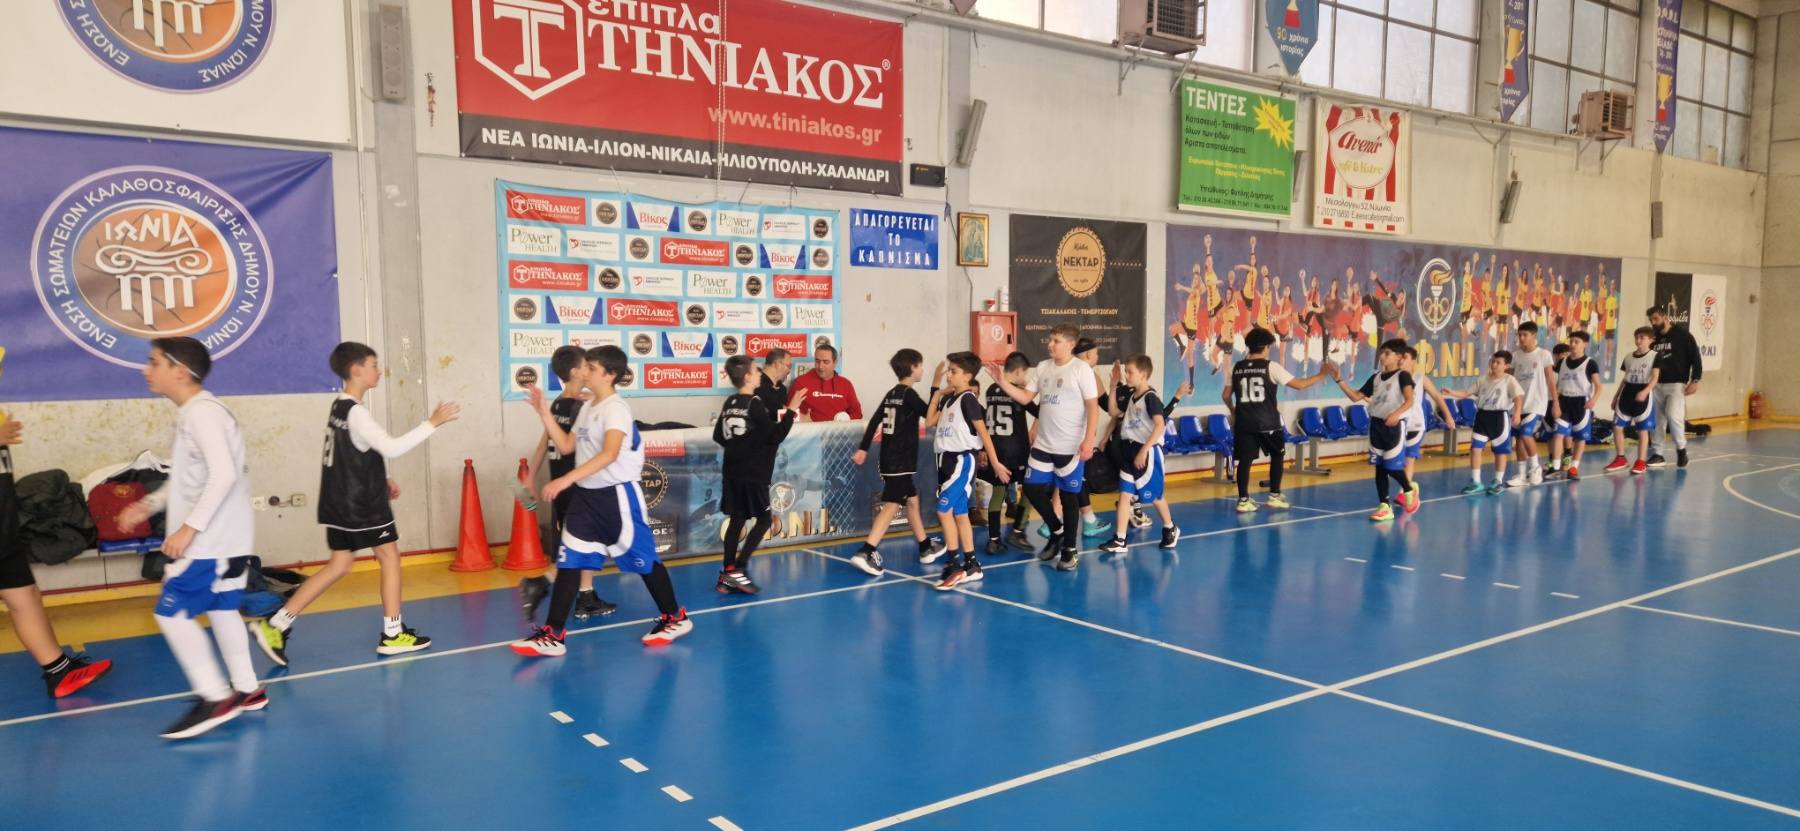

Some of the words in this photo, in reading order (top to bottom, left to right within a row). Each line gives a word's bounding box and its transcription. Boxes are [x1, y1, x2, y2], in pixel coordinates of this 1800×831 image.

[77, 13, 131, 66] ΕΝΩΣΗ
[198, 48, 248, 83] ΙΩΝΙΑΣ
[588, 20, 884, 109] ΤΗΝΙΑΚΟΣ
[1186, 86, 1247, 117] ΤΕΝΤΕΣ
[481, 128, 525, 148] ΝΕΑ
[708, 107, 882, 147] www.tiniakos.gr
[84, 178, 248, 240] ΚΑΛΑΘΟΣΦΑΙΡΙΣΗΣ
[640, 212, 668, 227] Βίκος
[855, 213, 935, 231] ΑΠΑΓΟΡΕΥΕΤΑΙ
[48, 202, 89, 298] ΣΩΜΑΤΕΙΩΝ
[888, 233, 901, 246] ΤΟ
[238, 241, 260, 299] ΔΗΜΟΥ
[771, 252, 795, 263] Βίκος
[858, 252, 930, 266] ΚΑΠΝΙΣΜΑ
[1063, 256, 1099, 268] ΝΕΚΤΑΡ
[61, 300, 117, 349] ΕΝΩΣΗ
[559, 306, 591, 319] Βίκος
[202, 316, 243, 350] ΙΩΝΙΑ
[673, 341, 702, 352] Βίκος
[1239, 377, 1265, 403] 16
[986, 405, 1014, 436] 45
